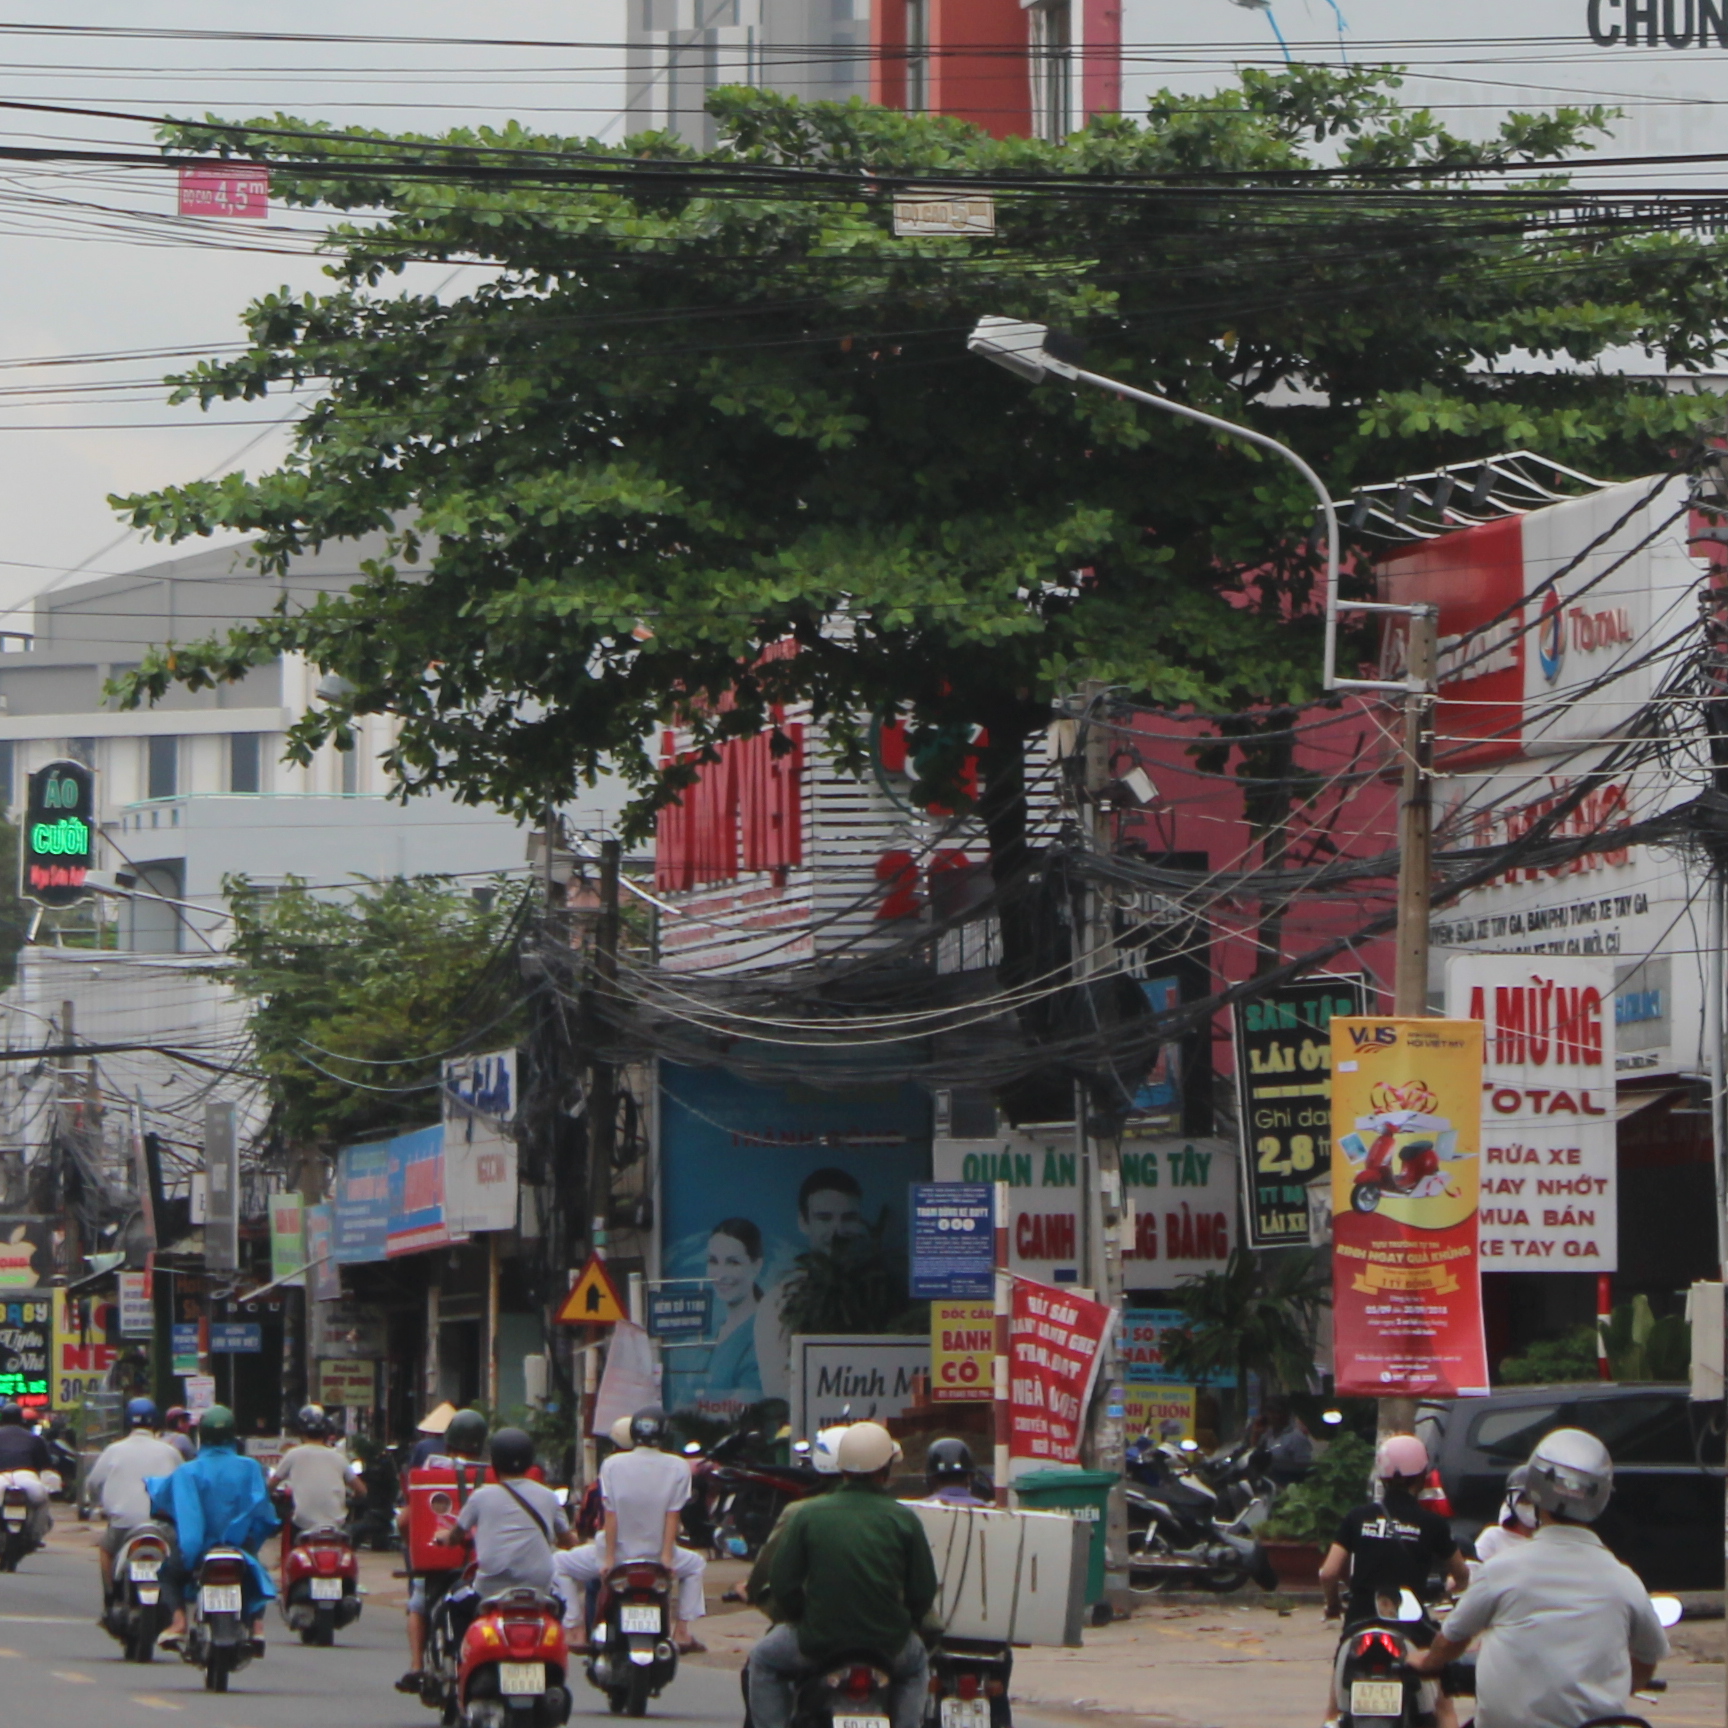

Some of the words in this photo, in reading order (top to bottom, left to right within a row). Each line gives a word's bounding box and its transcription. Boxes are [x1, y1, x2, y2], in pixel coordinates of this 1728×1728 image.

[1569, 607, 1633, 654] TOTAL
[43, 770, 79, 808] ÁO
[1495, 974, 1603, 1065] MỪNG
[1299, 1037, 1331, 1071] ÔT
[1483, 1083, 1606, 1115] OTAL
[1255, 1108, 1291, 1129] Ghi
[962, 1144, 1032, 1188] QUÁN
[1042, 1145, 1076, 1187] ĂN
[1166, 1144, 1213, 1187] TÂY
[1257, 1134, 1315, 1177] 2,8
[1487, 1143, 1540, 1165] RỬA
[1547, 1147, 1582, 1165] XE
[1480, 1178, 1527, 1195] HAY
[1536, 1173, 1608, 1195] NHỚT
[1480, 1209, 1530, 1226] MUA
[1543, 1204, 1596, 1227] BÁN
[1016, 1211, 1076, 1260] CANH
[1510, 1239, 1555, 1257] TAY
[1563, 1239, 1600, 1257] GA
[943, 1324, 993, 1351] BÁNH
[817, 1365, 886, 1397] Minh
[941, 1356, 980, 1384] CÔ
